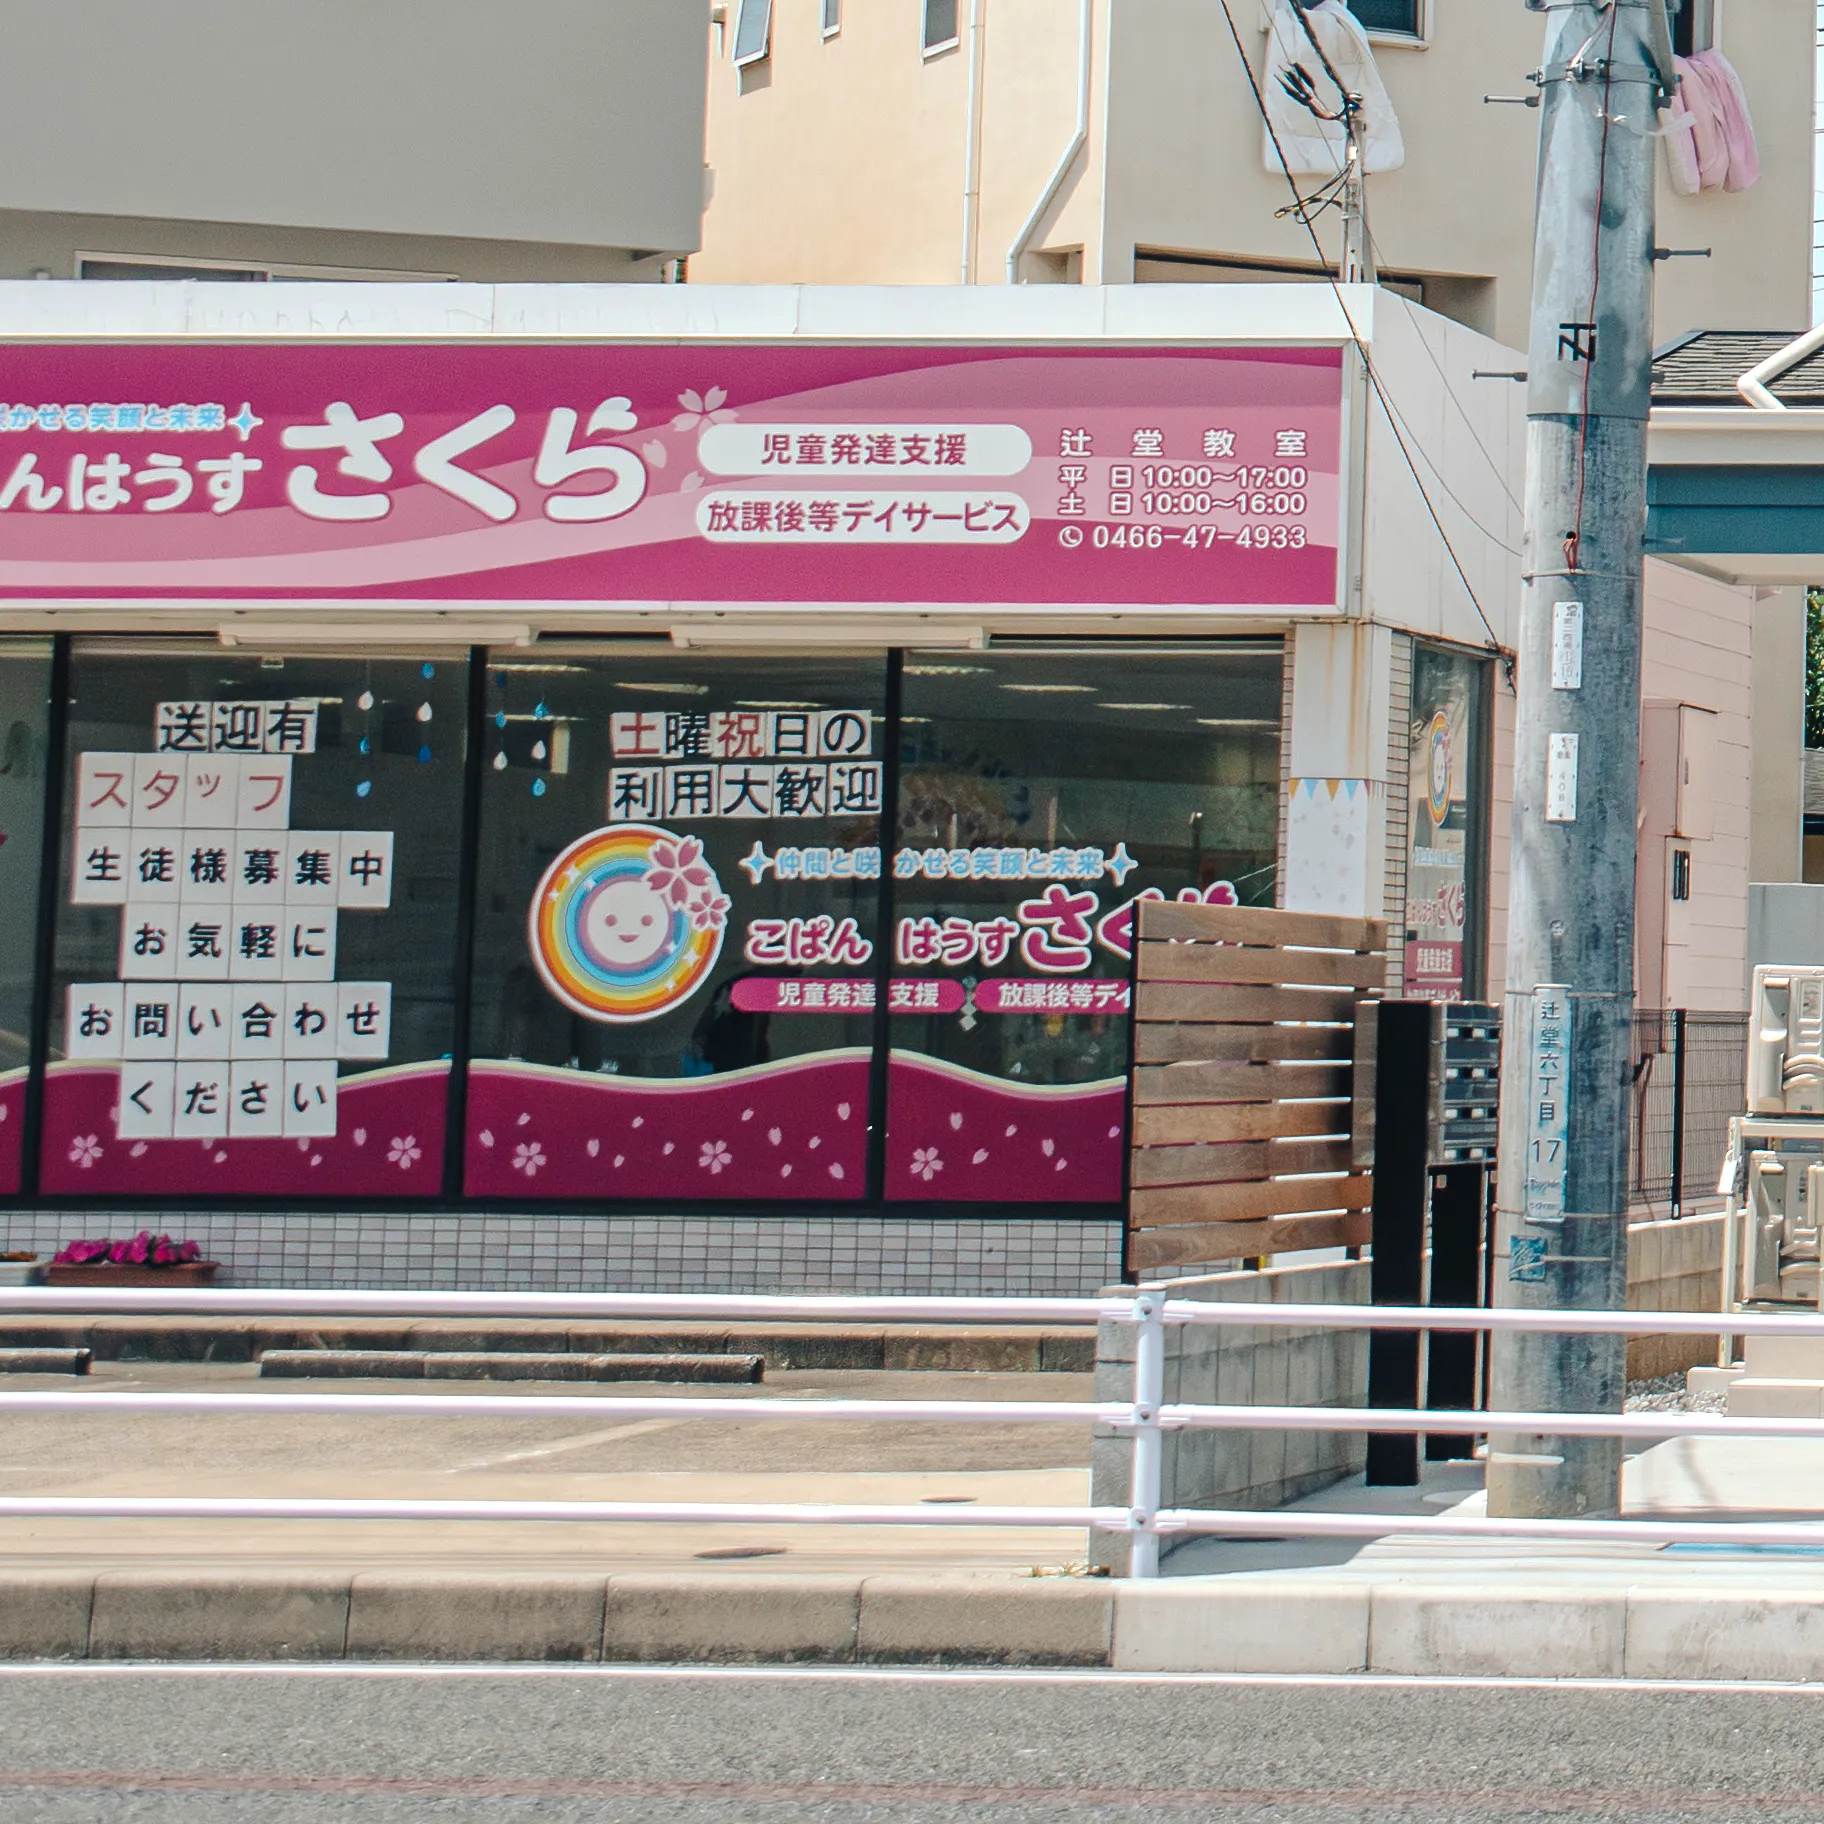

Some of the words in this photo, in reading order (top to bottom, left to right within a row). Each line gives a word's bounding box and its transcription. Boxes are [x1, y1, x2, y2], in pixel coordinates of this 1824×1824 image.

[281, 395, 647, 522] さくら
[761, 432, 967, 466] 児童発達支援
[707, 500, 1021, 533] 放課後等デイサービス
[159, 706, 313, 751] 送迎有
[616, 712, 867, 756] 土曜祝日の
[90, 770, 285, 811] スタッフ
[612, 767, 881, 818] 利用大歓迎
[84, 848, 385, 887] 生徒様募集中
[134, 922, 328, 959] お気軽に
[80, 1001, 381, 1038] お問い合わせ
[1539, 1001, 1561, 1121] 辻堂六丁目
[129, 1079, 327, 1115] ください
[1532, 1138, 1562, 1163] 17
